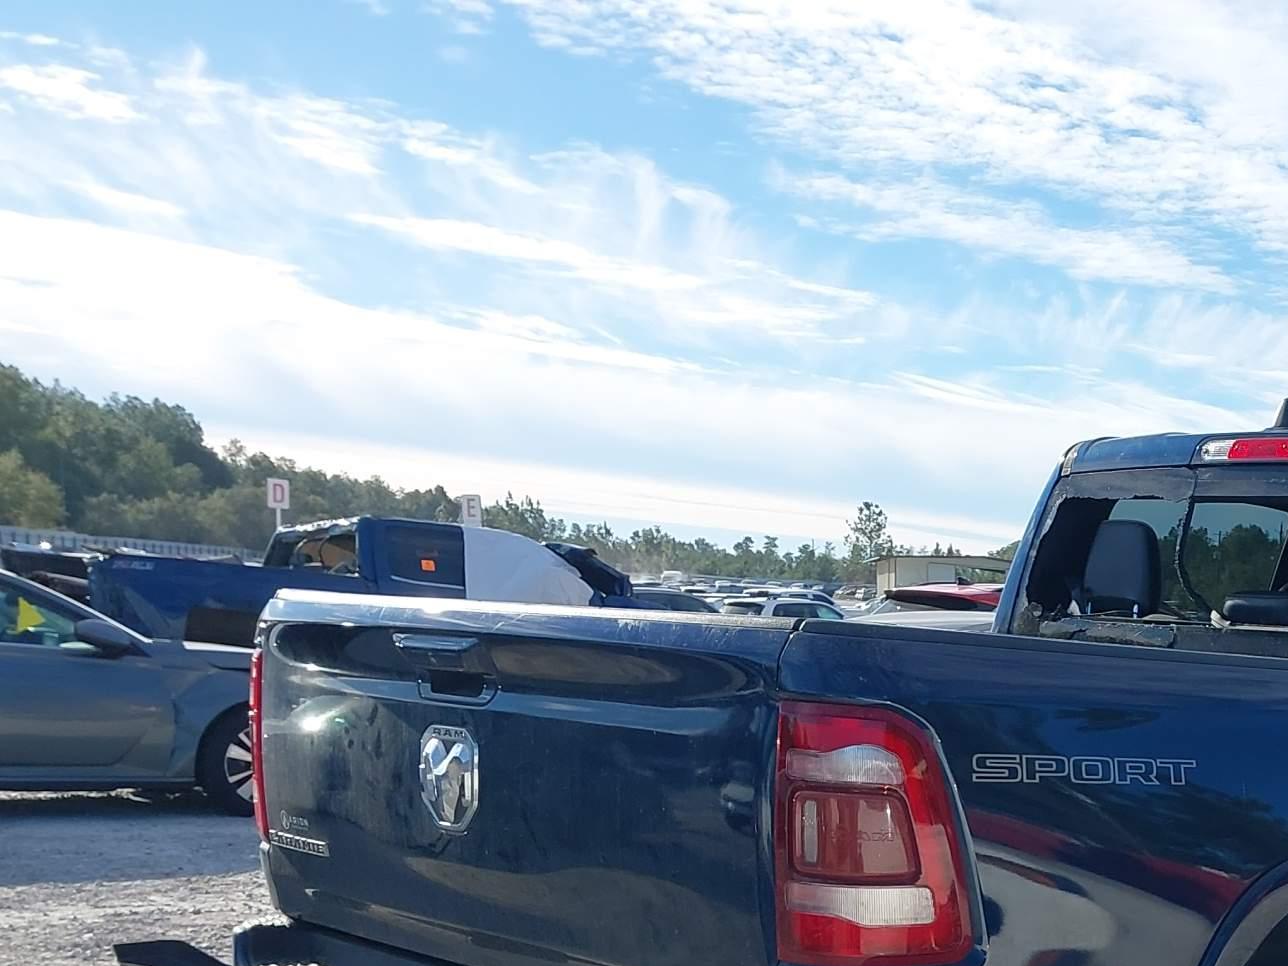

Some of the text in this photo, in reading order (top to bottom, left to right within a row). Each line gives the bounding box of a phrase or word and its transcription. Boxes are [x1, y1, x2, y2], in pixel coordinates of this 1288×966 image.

[273, 483, 285, 504] D
[466, 498, 476, 518] E
[432, 727, 465, 738] RAM
[972, 753, 1197, 785] SPORT
